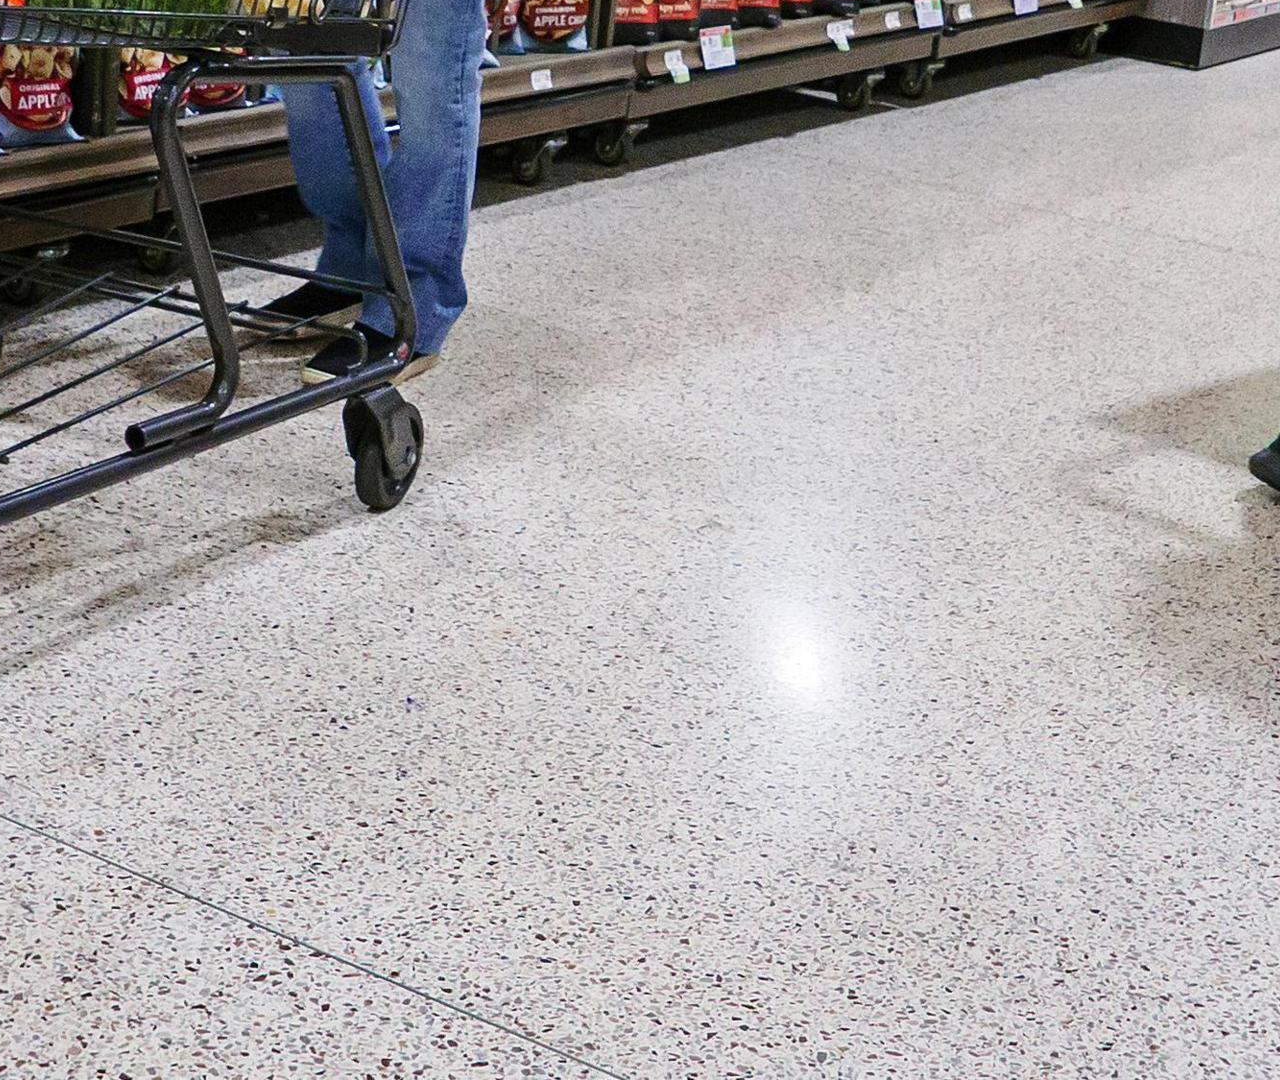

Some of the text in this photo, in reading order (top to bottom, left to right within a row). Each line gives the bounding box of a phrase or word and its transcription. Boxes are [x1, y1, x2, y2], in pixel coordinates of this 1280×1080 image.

[534, 15, 566, 27] APPLE
[19, 83, 60, 93] ORIGINAL
[134, 84, 160, 101] APP
[18, 94, 57, 110] APPLE
